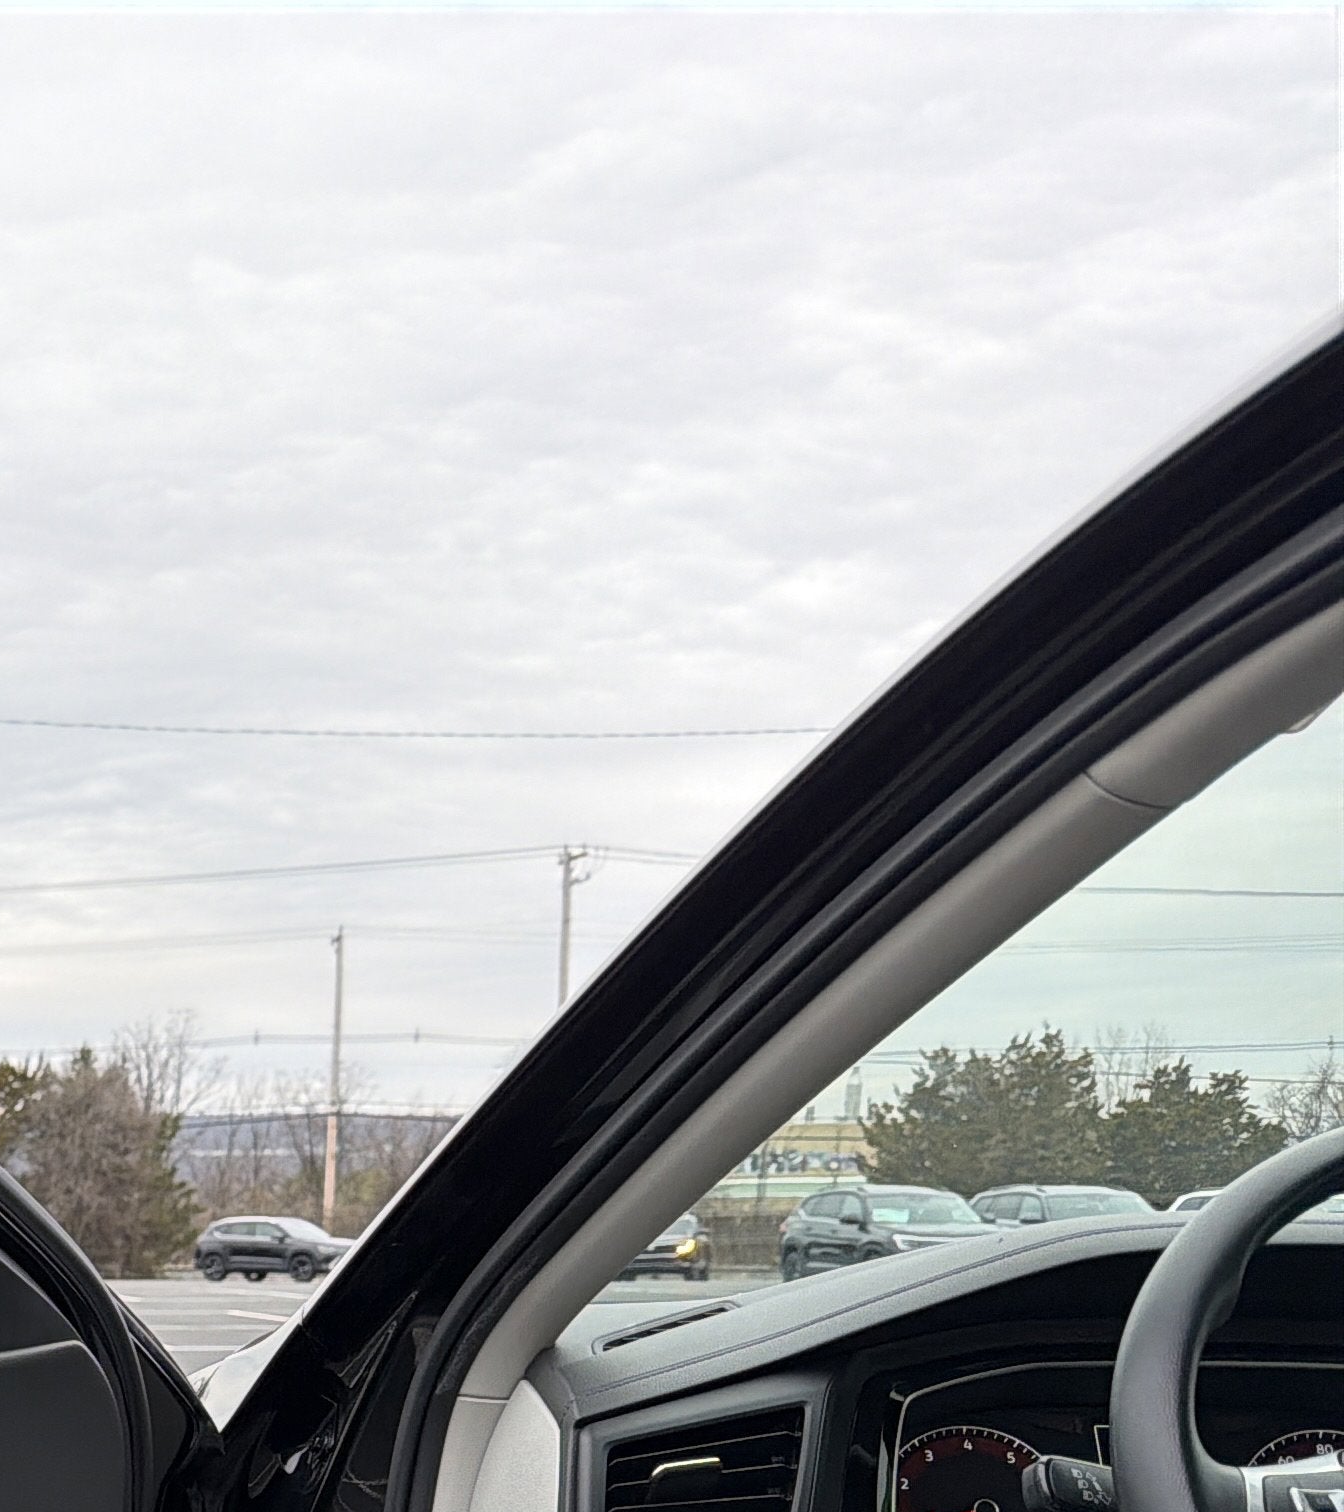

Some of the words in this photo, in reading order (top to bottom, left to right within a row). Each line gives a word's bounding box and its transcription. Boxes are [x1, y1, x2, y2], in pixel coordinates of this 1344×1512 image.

[963, 1439, 972, 1450] 4
[1316, 1444, 1333, 1454] 80
[924, 1450, 934, 1462] 3
[1006, 1452, 1016, 1464] 5
[900, 1478, 909, 1490] 2
